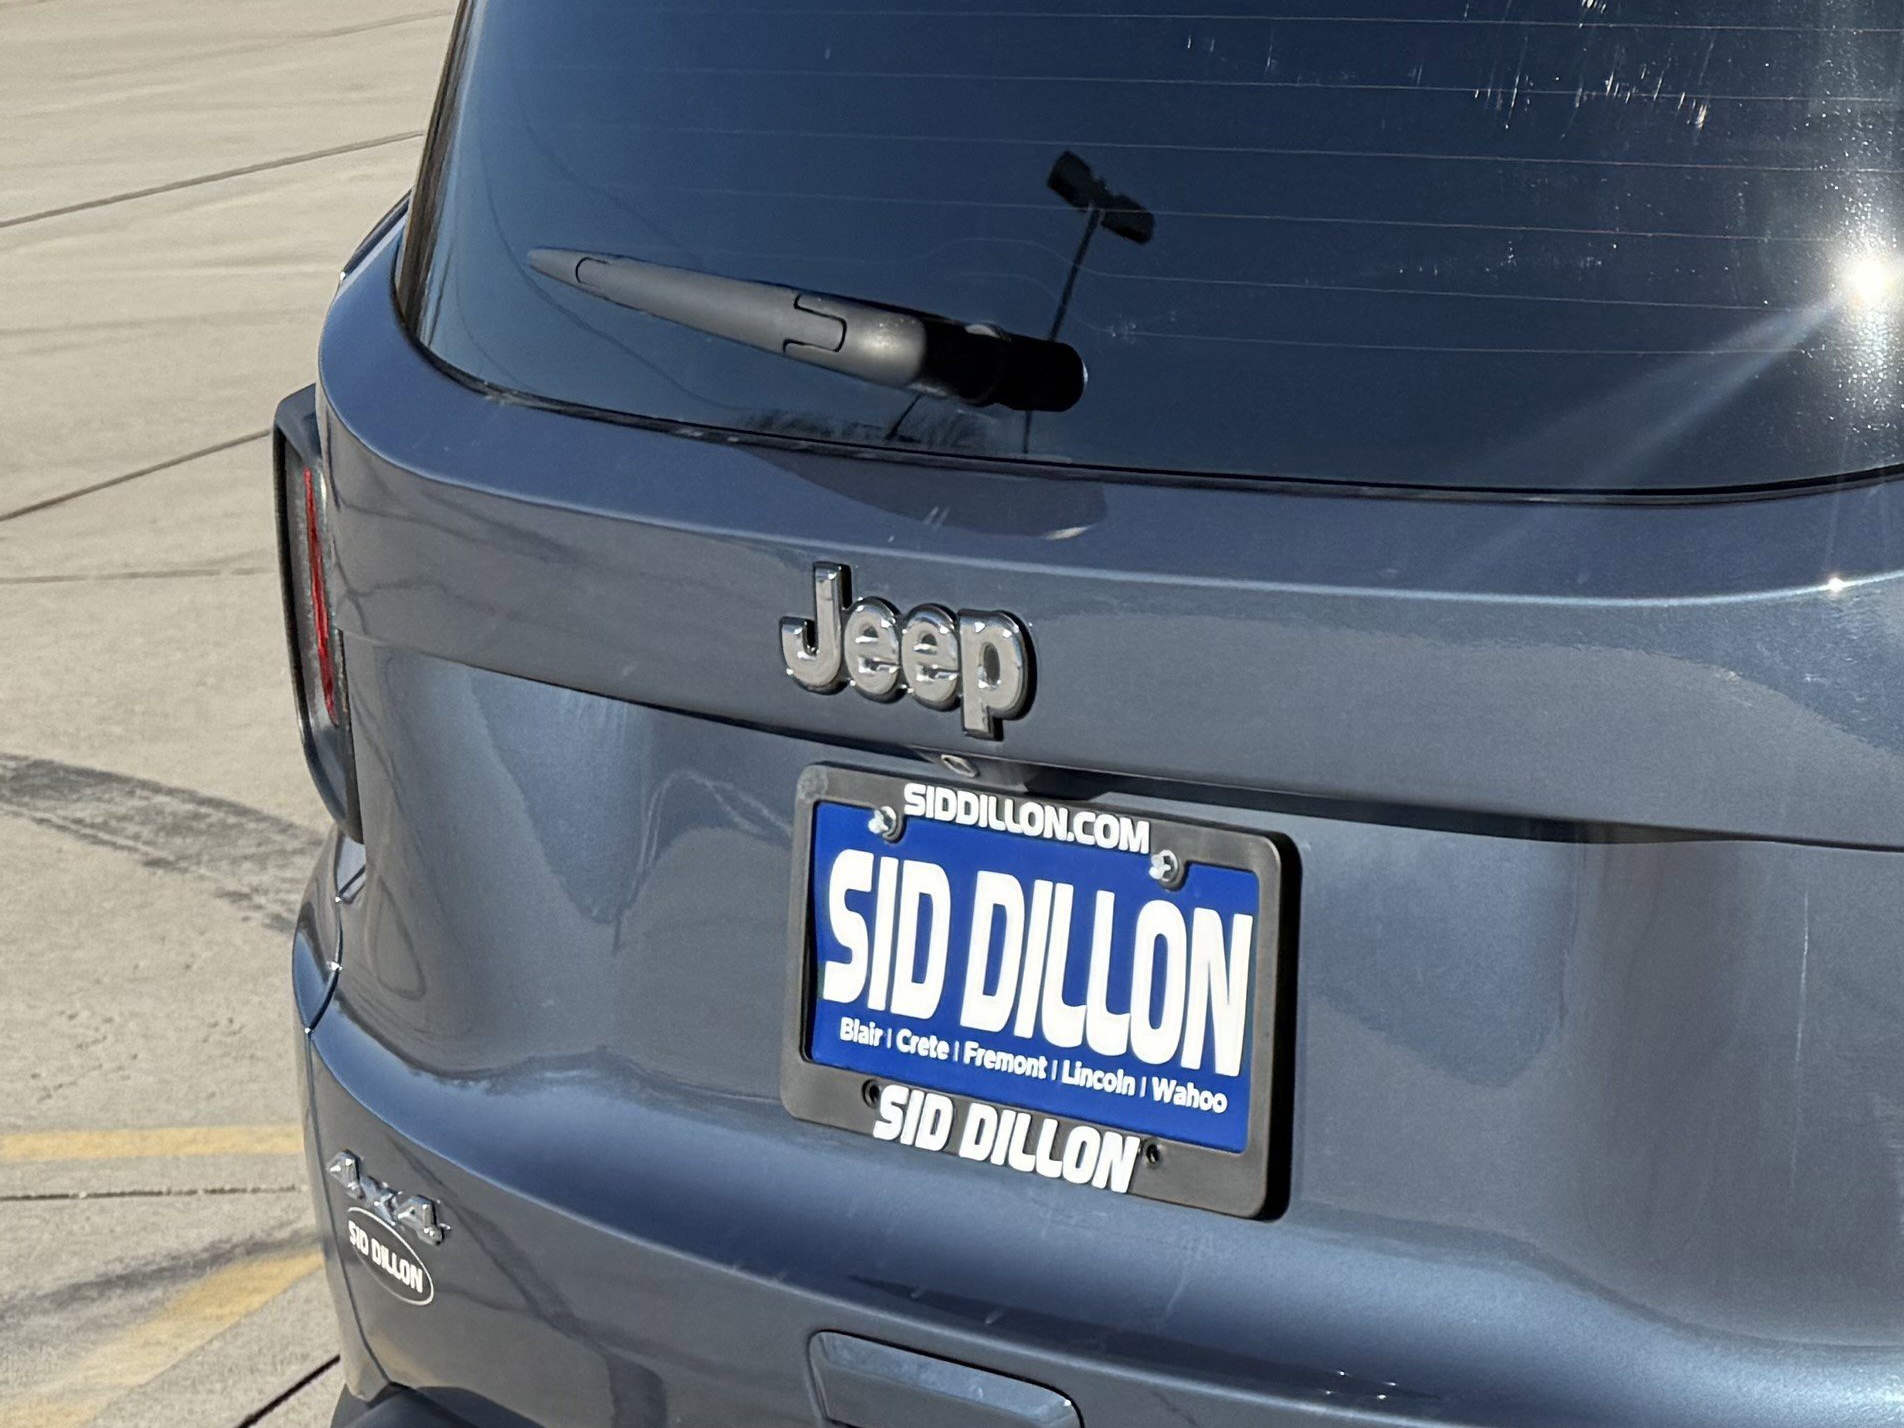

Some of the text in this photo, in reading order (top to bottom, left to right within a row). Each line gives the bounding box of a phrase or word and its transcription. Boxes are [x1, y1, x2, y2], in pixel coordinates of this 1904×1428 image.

[780, 560, 1036, 739] Jeep
[903, 782, 1151, 856] SIDDILLON.COM
[822, 848, 1255, 1078] SID DILLON
[838, 1016, 1229, 1115] Blair Crete Fremont Lincoln Wahoo
[871, 1083, 1142, 1195] SID DILLON
[348, 1220, 424, 1294] SID DILLON
